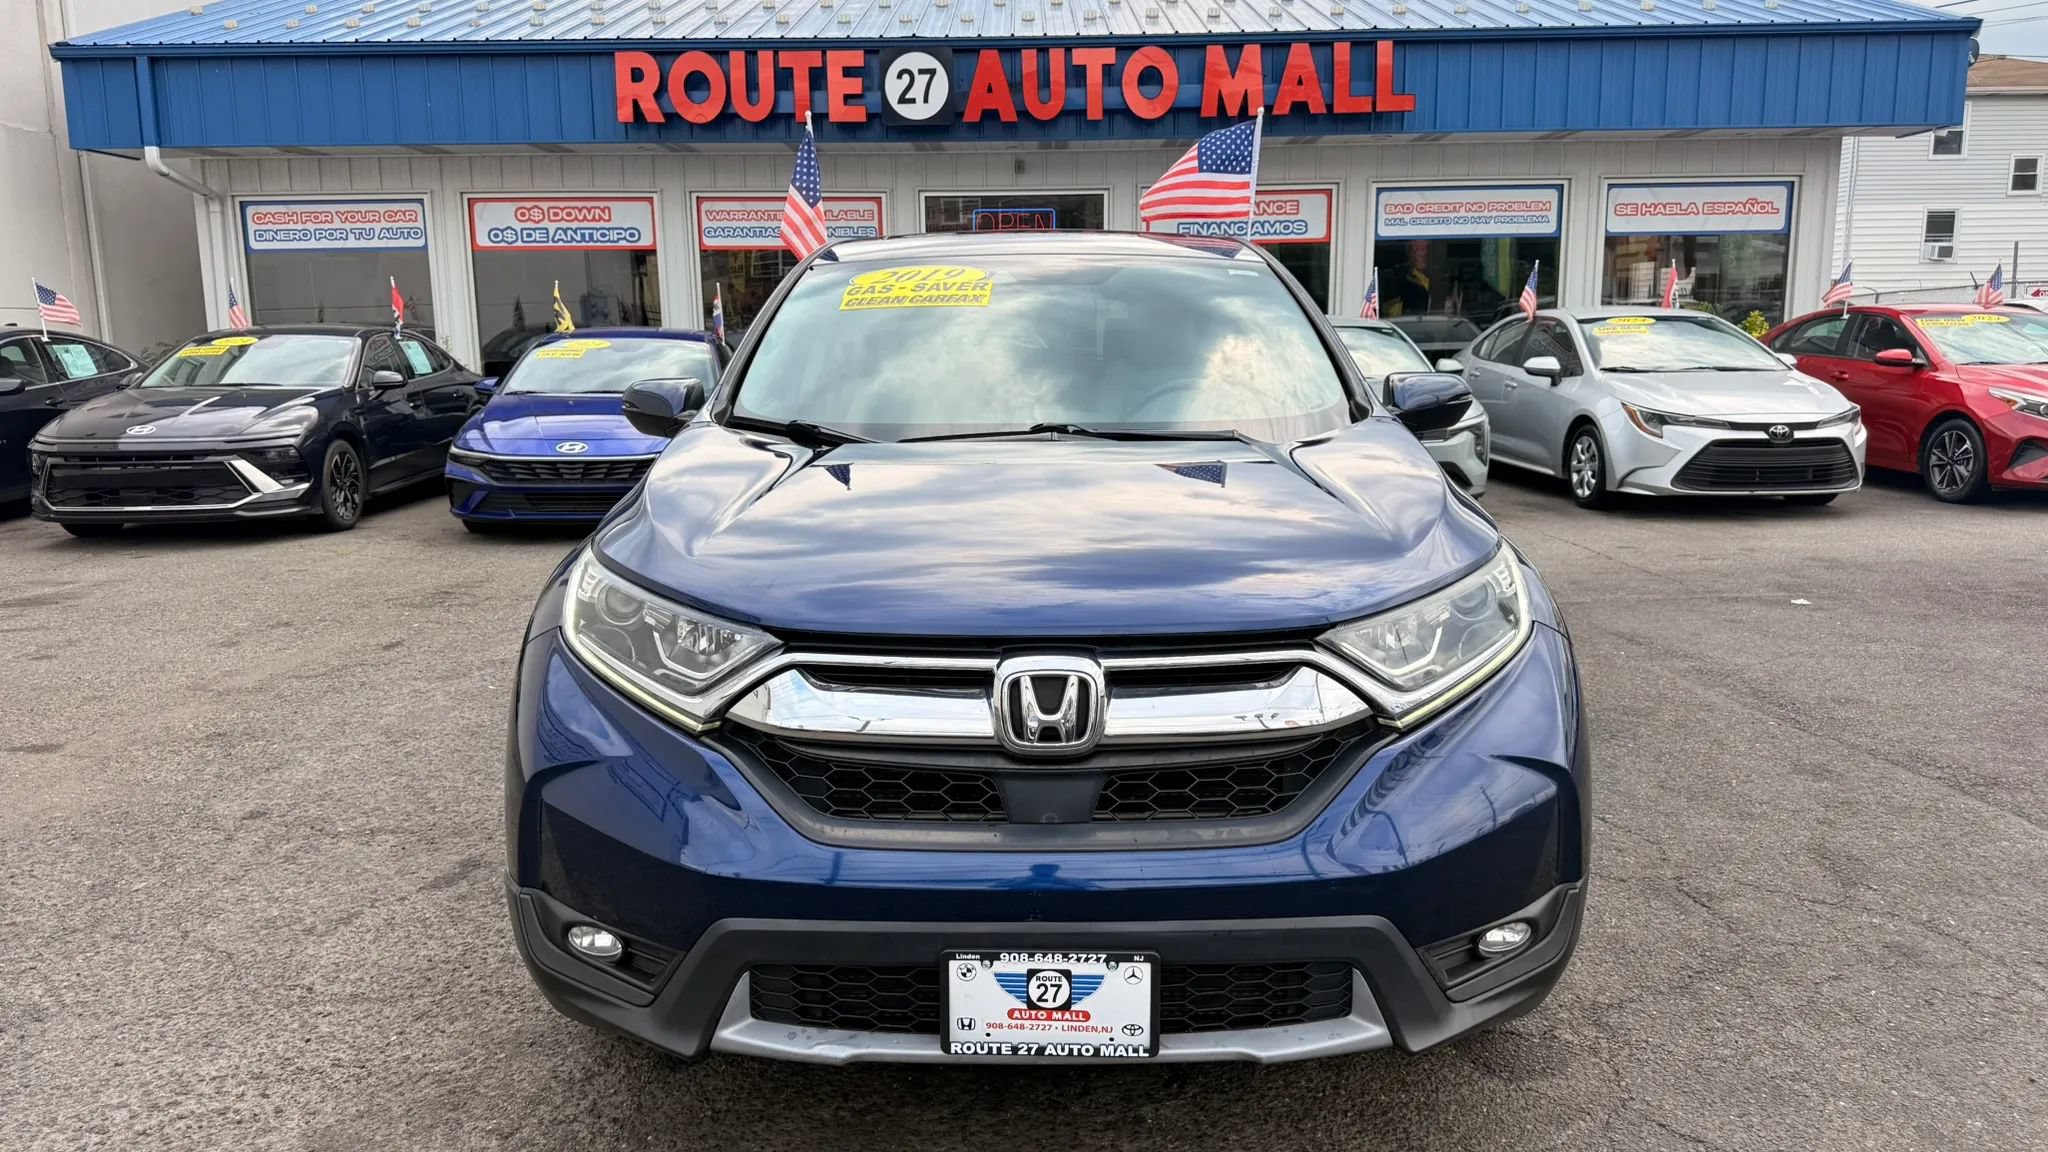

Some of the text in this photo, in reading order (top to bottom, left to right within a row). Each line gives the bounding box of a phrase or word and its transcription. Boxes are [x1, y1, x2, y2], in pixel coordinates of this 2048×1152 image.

[614, 39, 1417, 124] ROUTE 27 AUTO MALL
[547, 205, 612, 223] DOWN
[1384, 201, 1551, 214] BAD CREDIT NO PROBLEM
[1614, 197, 1779, 216] SE HABLA ESPAÑOL
[253, 209, 418, 225] CASH FOR YOUR CAR
[704, 210, 784, 222] WARRANTIE
[1384, 215, 1549, 226] MAL CREDITO NO HAY PROBLEMA
[254, 226, 423, 242] DINERO POR TU AUTO
[520, 227, 550, 243] DE
[551, 227, 642, 243] ANTICIPO
[1177, 220, 1308, 236] FINANCAMOS
[873, 268, 966, 284] 2019
[847, 284, 894, 296] GAS
[910, 281, 988, 293] SAVER
[844, 294, 986, 307] CLEAN CARFAX
[999, 953, 1107, 964] 908-648-2727
[1036, 983, 1063, 1003] 27
[1012, 1010, 1086, 1021] AUTO MALL
[985, 1022, 1053, 1031] 908-648-2727
[950, 1042, 1150, 1057] ROUTE 27 AUTO MALL
